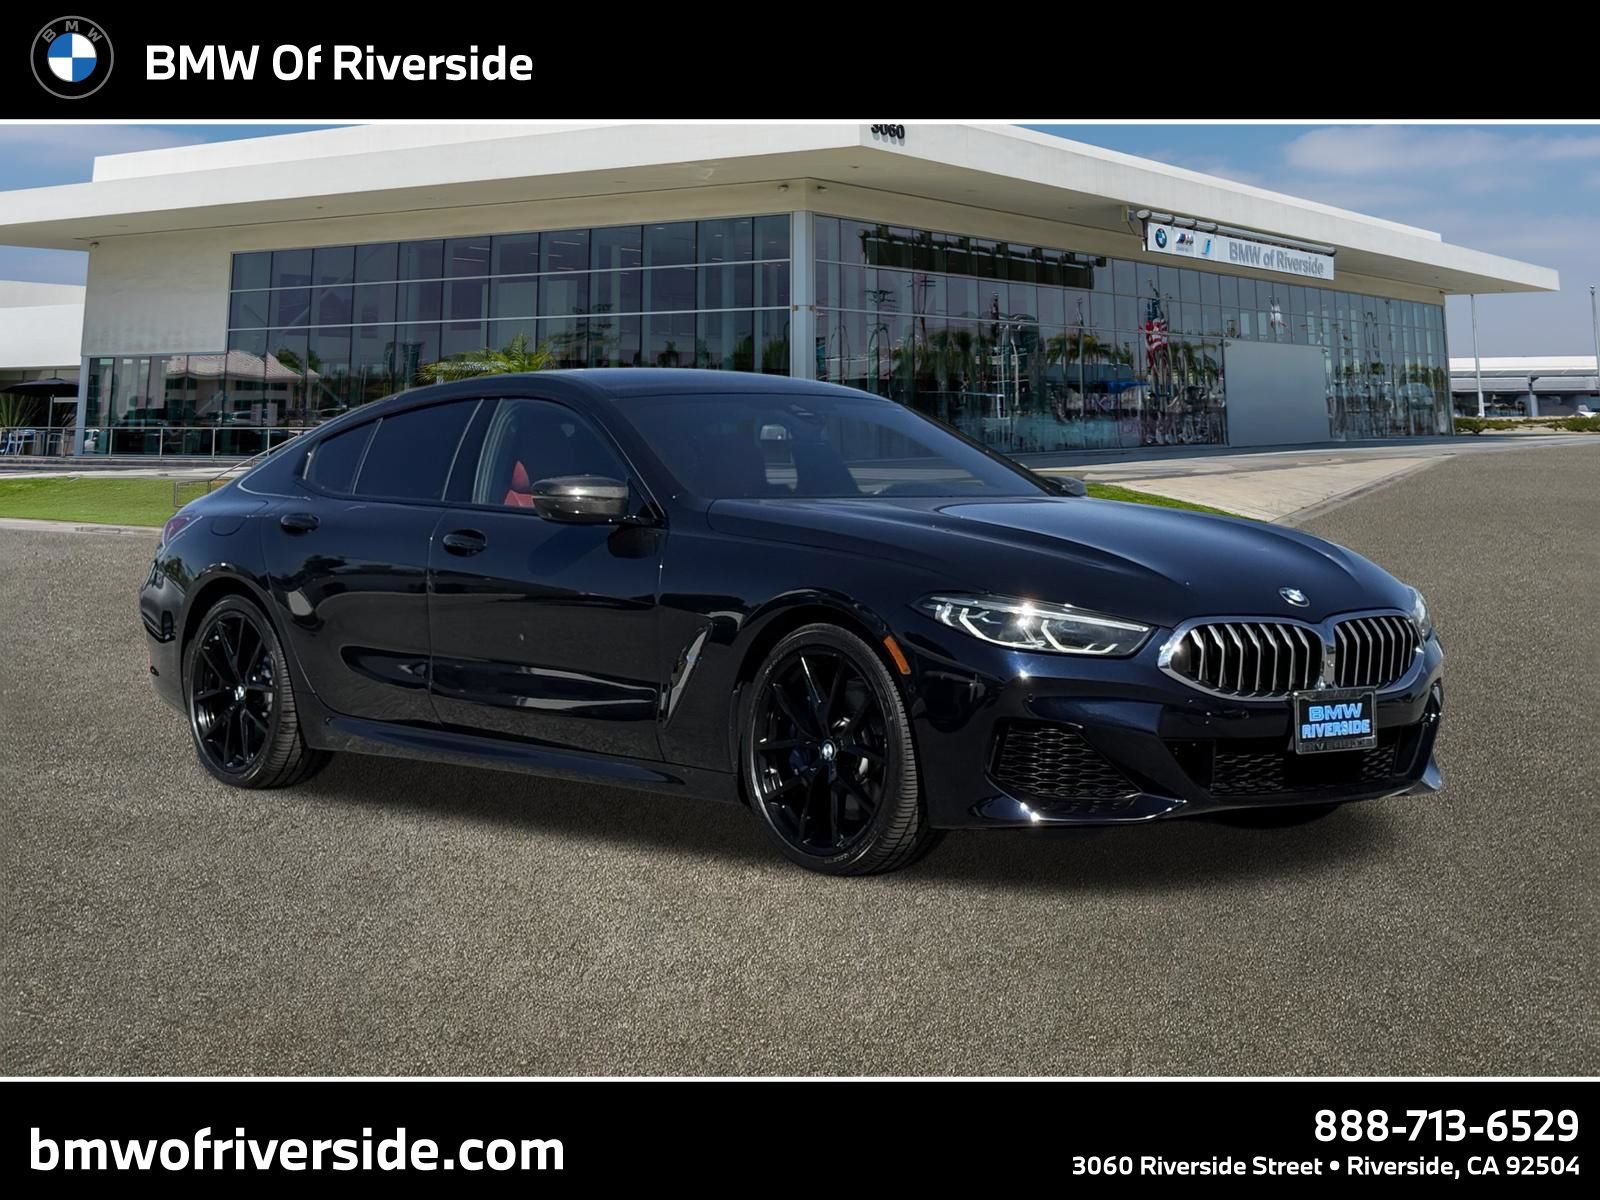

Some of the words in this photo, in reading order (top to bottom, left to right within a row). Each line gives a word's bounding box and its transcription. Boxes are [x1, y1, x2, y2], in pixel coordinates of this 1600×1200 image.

[1229, 241, 1261, 264] BMW
[1263, 250, 1275, 266] of
[1276, 251, 1324, 275] Riverside
[1308, 702, 1363, 722] BMW
[1301, 718, 1371, 739] RIVERSIDE
